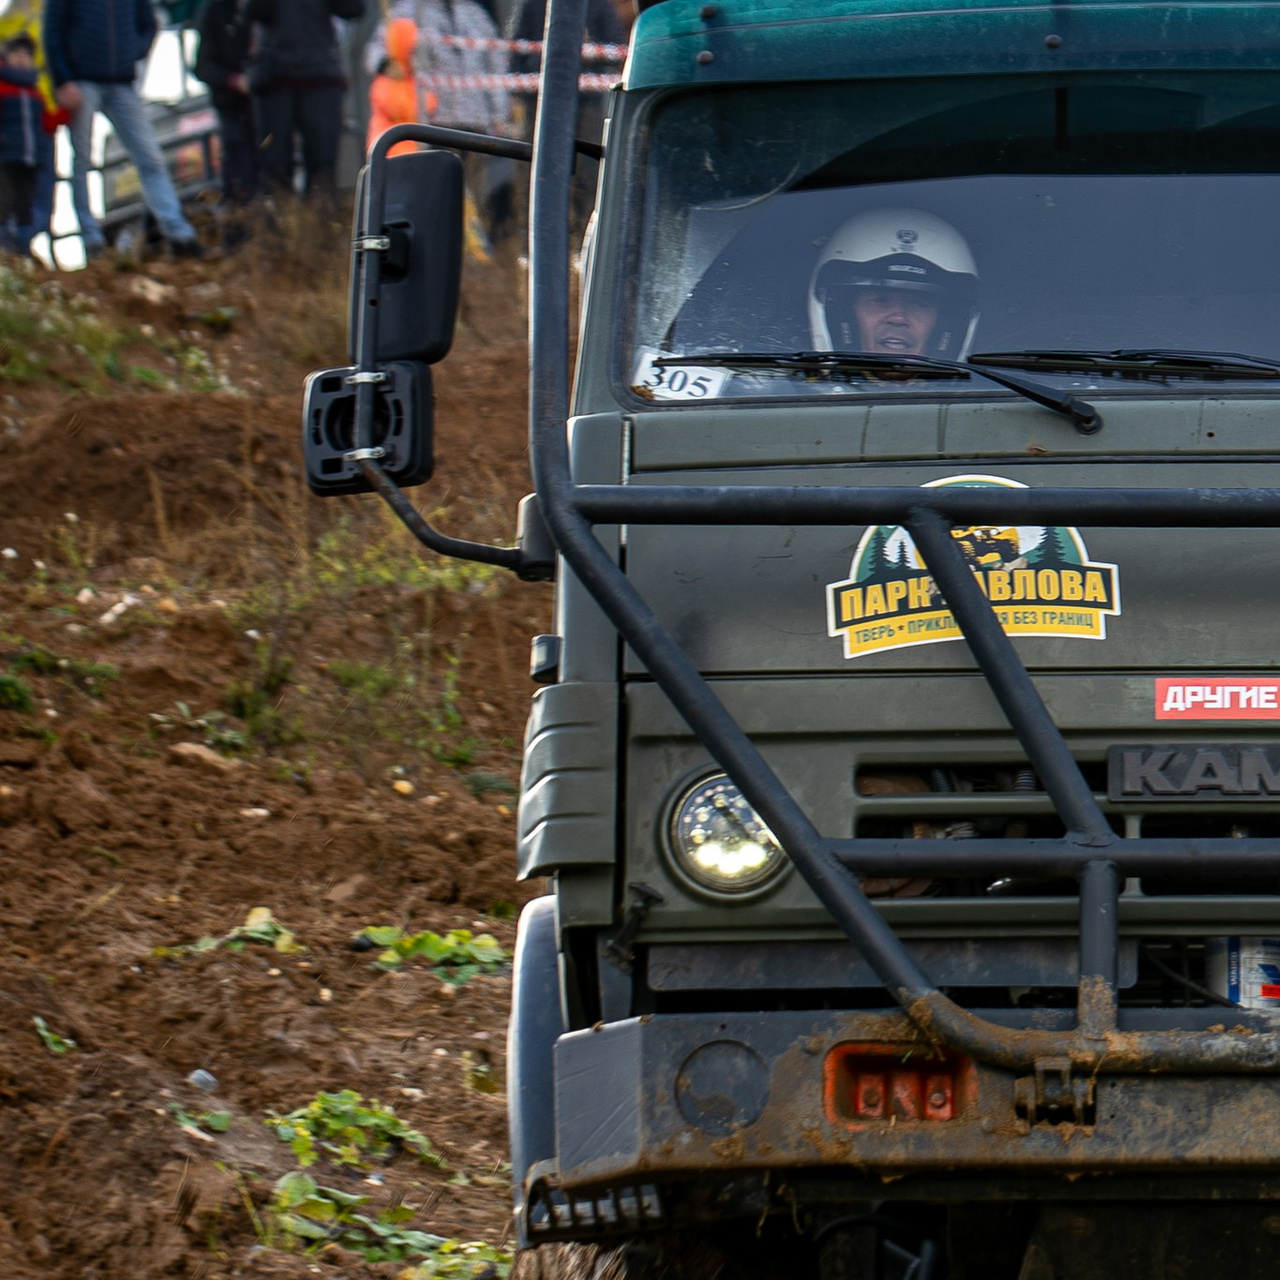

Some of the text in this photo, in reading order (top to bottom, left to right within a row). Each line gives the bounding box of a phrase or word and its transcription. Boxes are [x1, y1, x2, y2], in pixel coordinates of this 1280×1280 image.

[643, 366, 712, 397] 305
[840, 569, 1108, 621] ПАРК ВЛОВА
[855, 611, 1094, 645] ТВЕРЬ ПРИКЛЯ БЕЗ ГРАНИЦ
[1163, 685, 1279, 712] ДРУГИЕ
